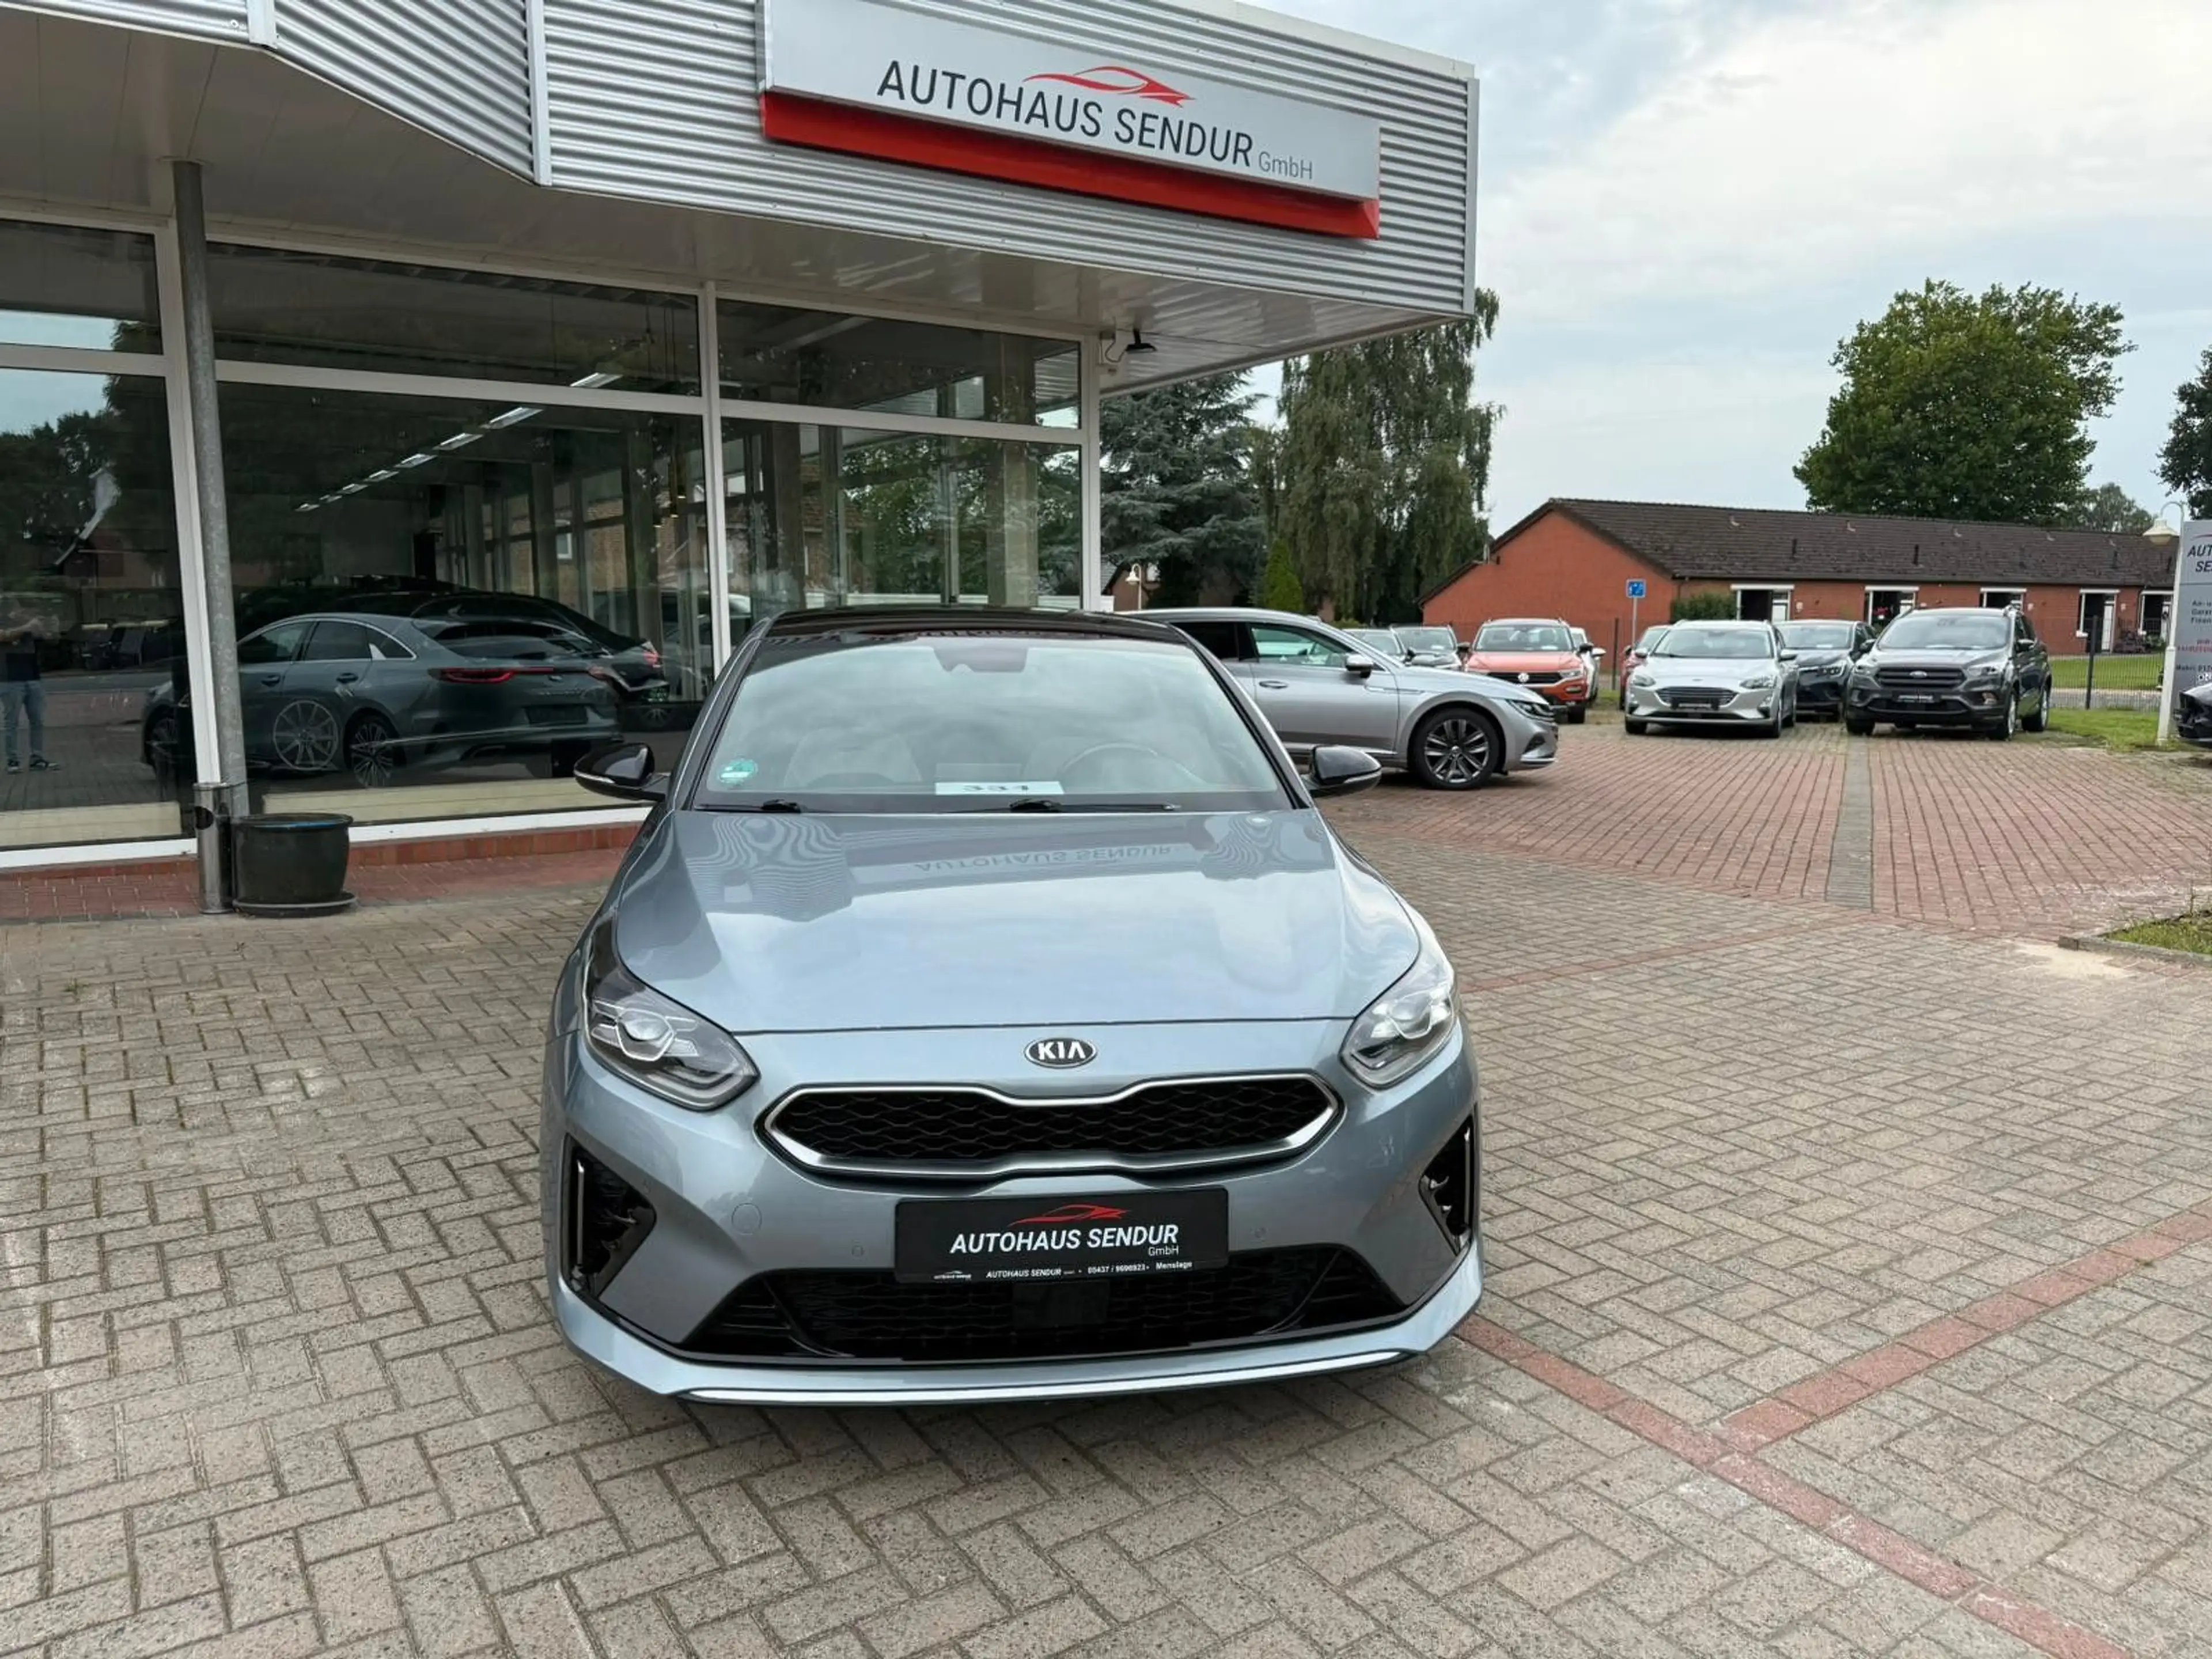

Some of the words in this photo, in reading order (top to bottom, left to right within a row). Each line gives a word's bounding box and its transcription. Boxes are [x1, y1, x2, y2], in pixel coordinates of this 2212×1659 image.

[877, 60, 1103, 137] AUTOHAUS
[1114, 108, 1253, 167] SENDUR
[1258, 151, 1313, 180] GmbH
[1037, 1041, 1086, 1060] KIA
[949, 1230, 1081, 1254] AUTOHAUS
[1086, 1225, 1179, 1248] SENDUR
[1148, 1245, 1179, 1256] GmbH
[986, 1270, 1029, 1279] AUTOHAUS
[1030, 1268, 1062, 1277] SENDUR
